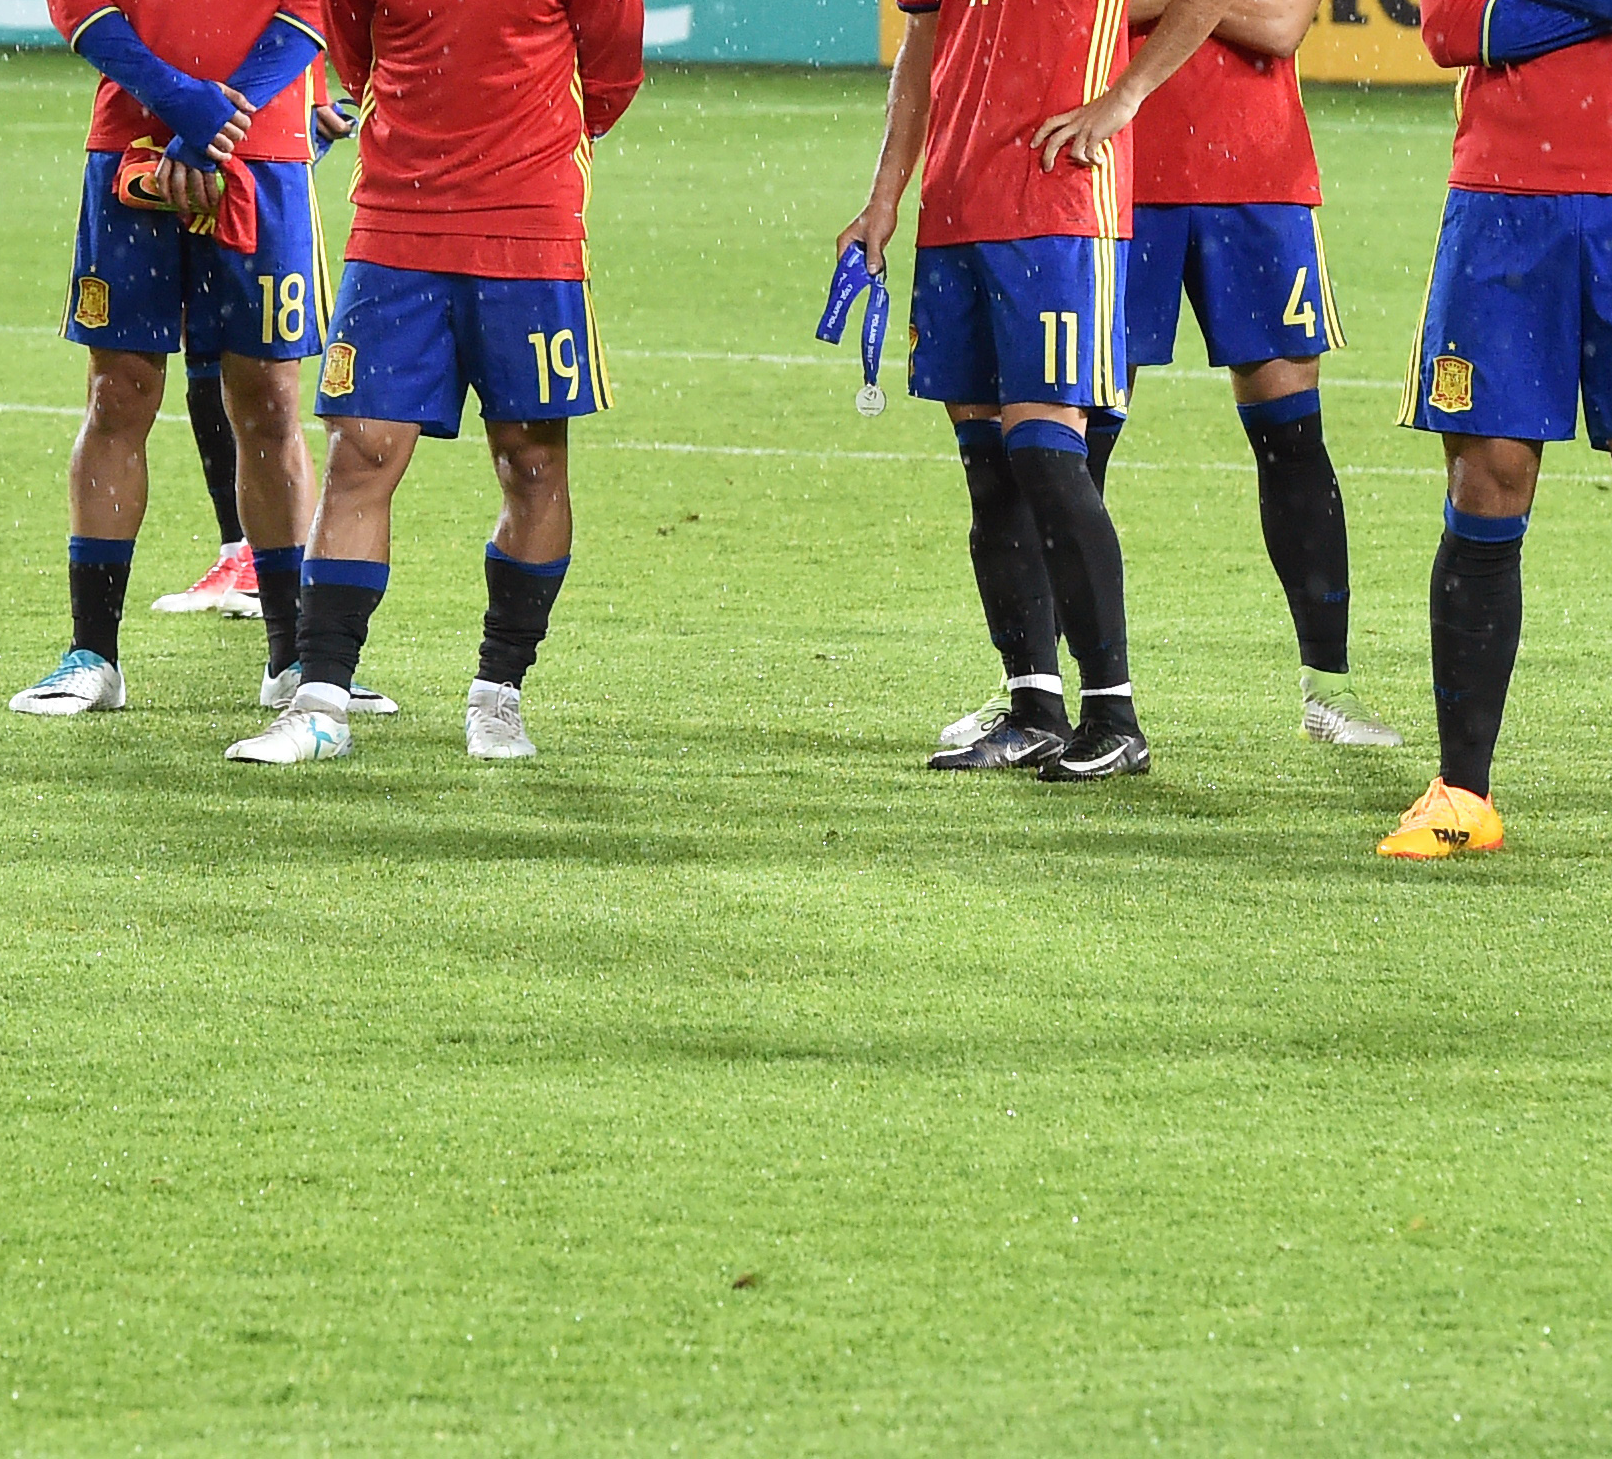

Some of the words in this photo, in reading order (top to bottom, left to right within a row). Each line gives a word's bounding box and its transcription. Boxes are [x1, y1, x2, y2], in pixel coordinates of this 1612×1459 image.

[258, 273, 306, 344] 18
[869, 314, 880, 344] POLAND
[1283, 267, 1317, 338] 4
[528, 329, 580, 404] 19
[1039, 311, 1078, 385] 11
